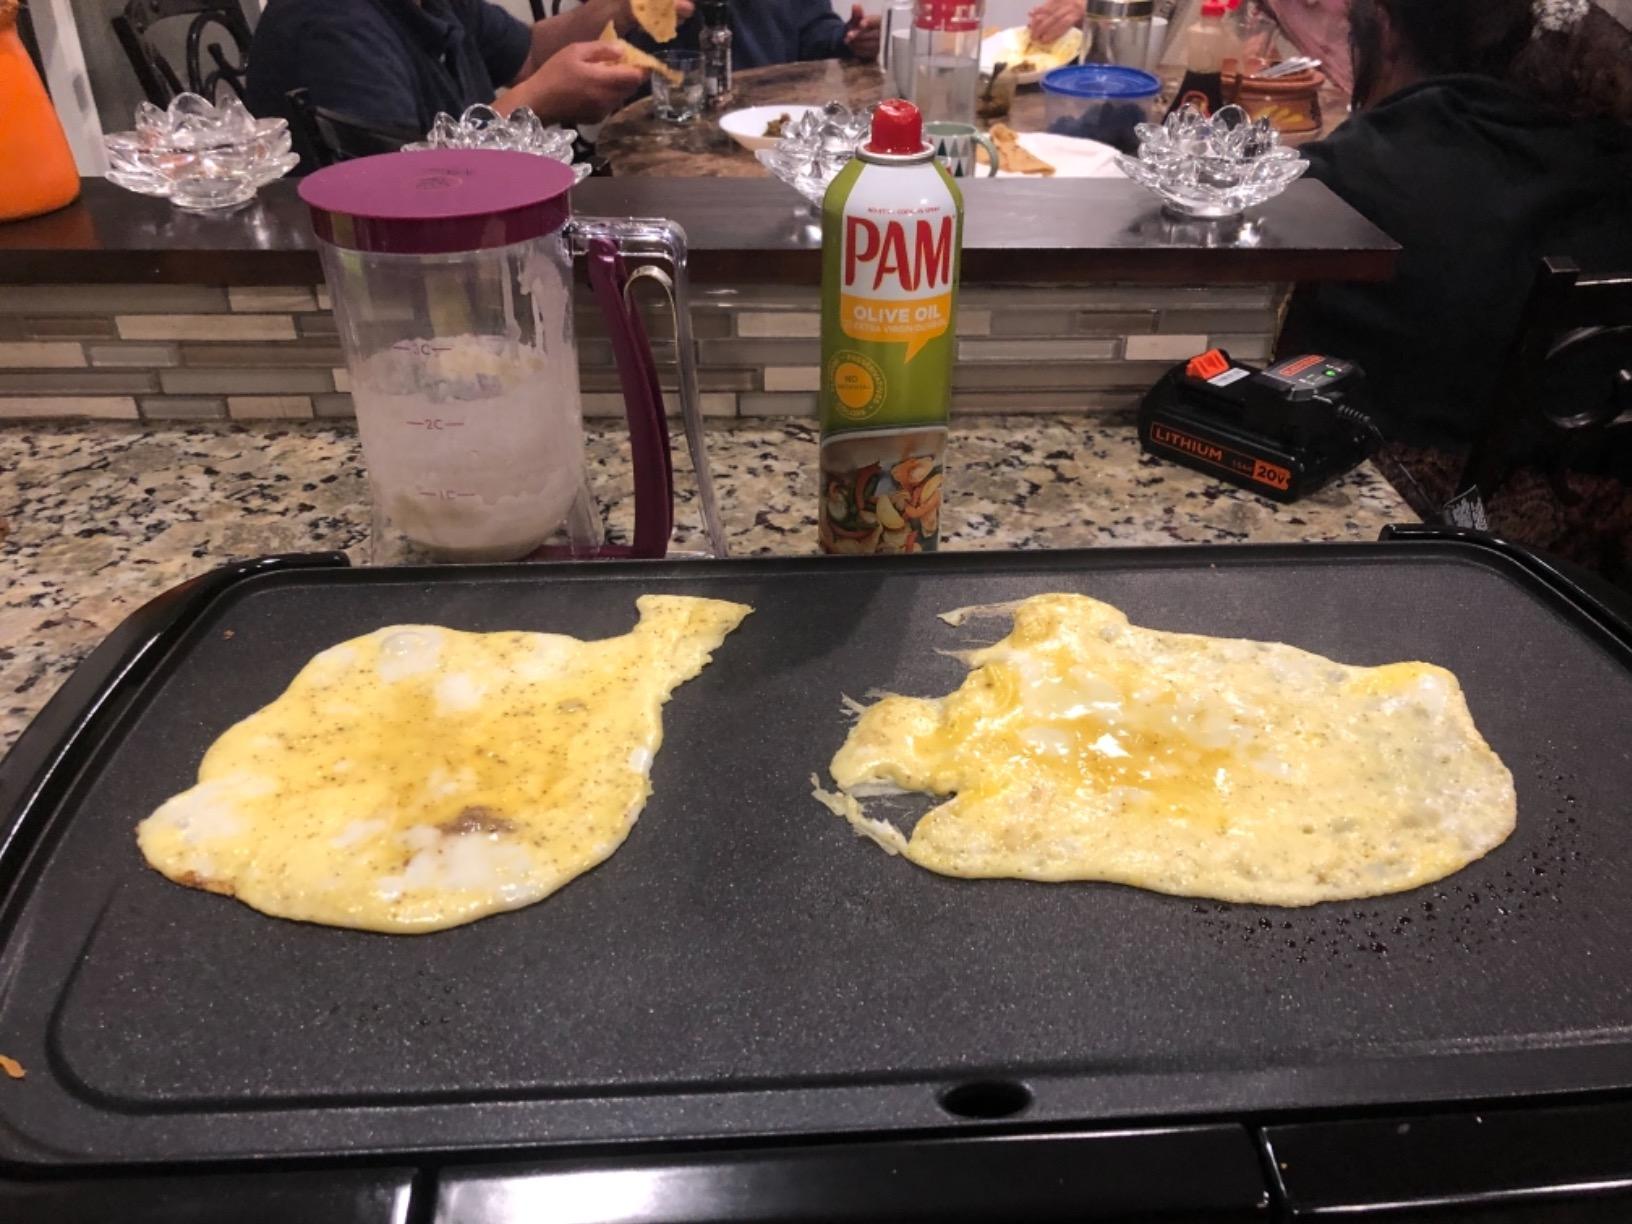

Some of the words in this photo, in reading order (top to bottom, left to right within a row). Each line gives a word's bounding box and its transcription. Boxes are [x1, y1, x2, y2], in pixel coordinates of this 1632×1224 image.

[845, 214, 952, 292] PAM
[854, 305, 910, 323] OLIVE
[915, 304, 942, 322] OIL
[425, 418, 444, 430] 2C
[1155, 427, 1223, 461] LITHIUM
